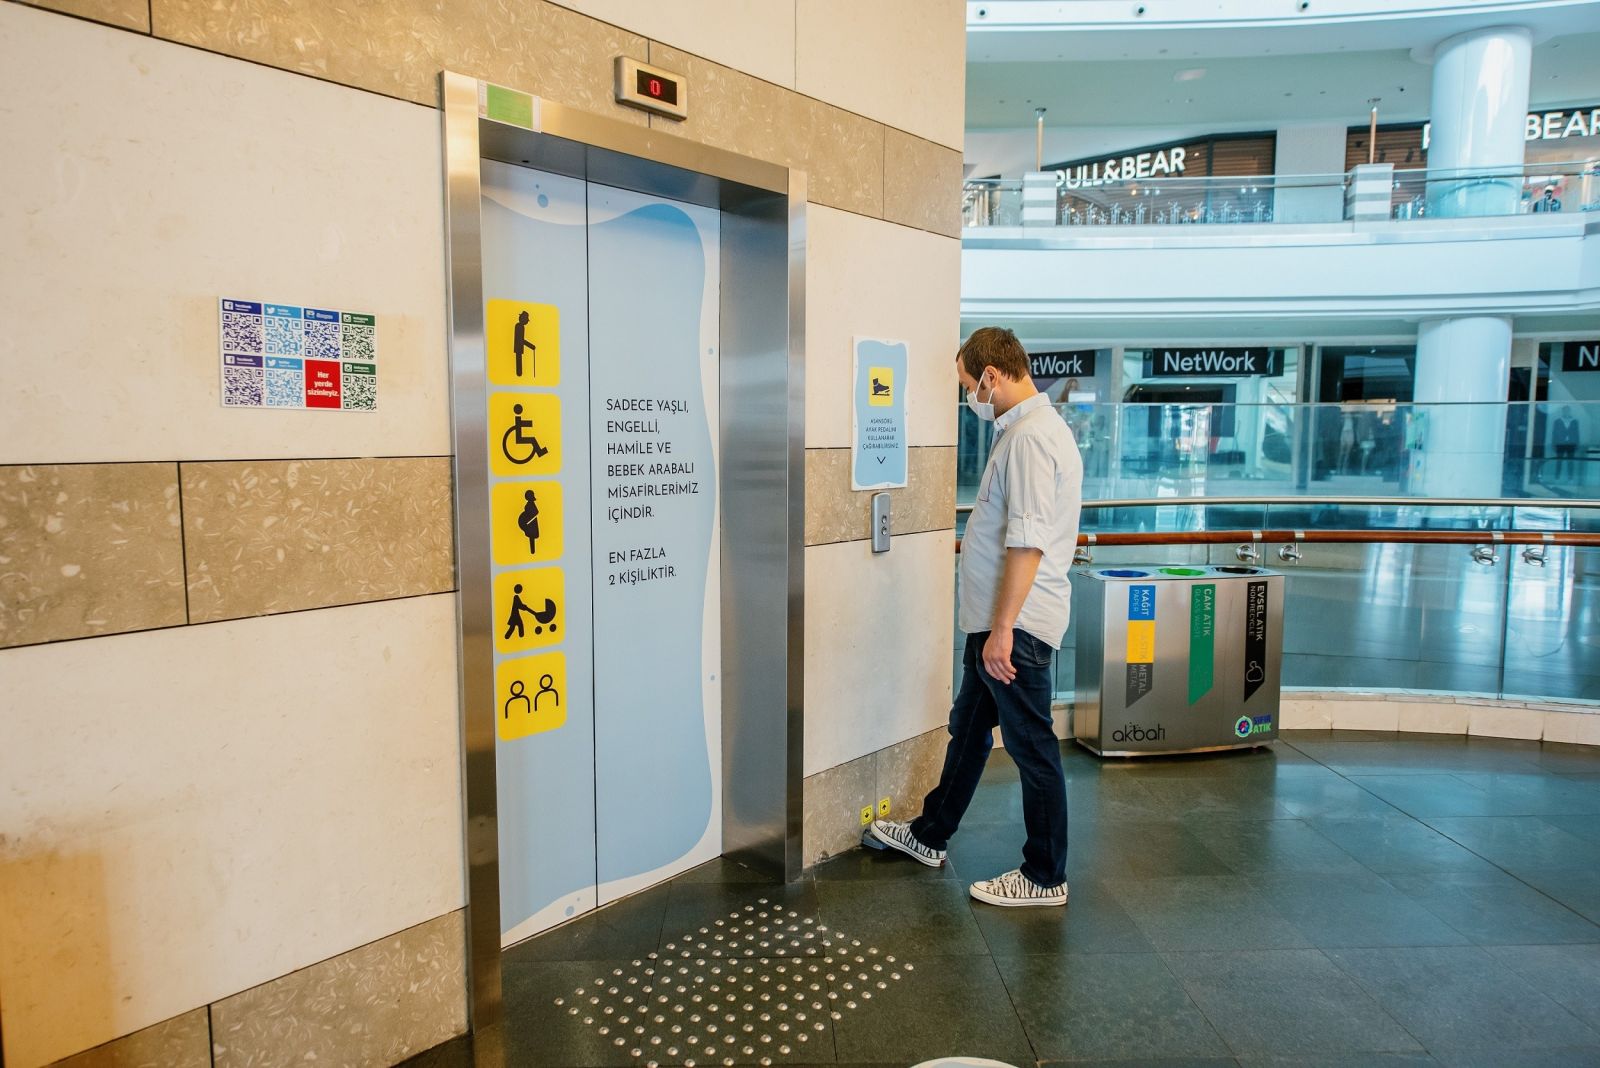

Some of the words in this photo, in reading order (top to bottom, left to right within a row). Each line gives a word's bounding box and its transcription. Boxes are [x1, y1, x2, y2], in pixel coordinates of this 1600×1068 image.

[650, 79, 661, 96] 0
[1031, 354, 1083, 376] tWork
[1163, 351, 1255, 373] NetWork
[314, 380, 333, 388] yerde
[606, 398, 653, 411] SADECE
[656, 399, 689, 415] YAŞLI,
[607, 418, 660, 434] ENGELLİ,
[607, 440, 653, 455] HAMİLE
[656, 442, 672, 454] VE
[607, 464, 645, 477] BEBEK
[648, 462, 694, 475] ARABALI
[608, 481, 699, 499] MİSAFİRLERİMİZ
[608, 504, 655, 523] İÇİNDİR.
[609, 550, 626, 564] EN
[630, 547, 666, 561] FAZLA
[608, 574, 615, 586] 2
[619, 565, 677, 585] KİŞİLİKTİR.
[1141, 589, 1150, 616] KAĞIT
[1202, 588, 1212, 611] CAM
[1256, 585, 1265, 618] EVSEL
[1202, 614, 1212, 636] ATIK
[1255, 619, 1264, 641] ATIK
[1138, 664, 1147, 694] METAL
